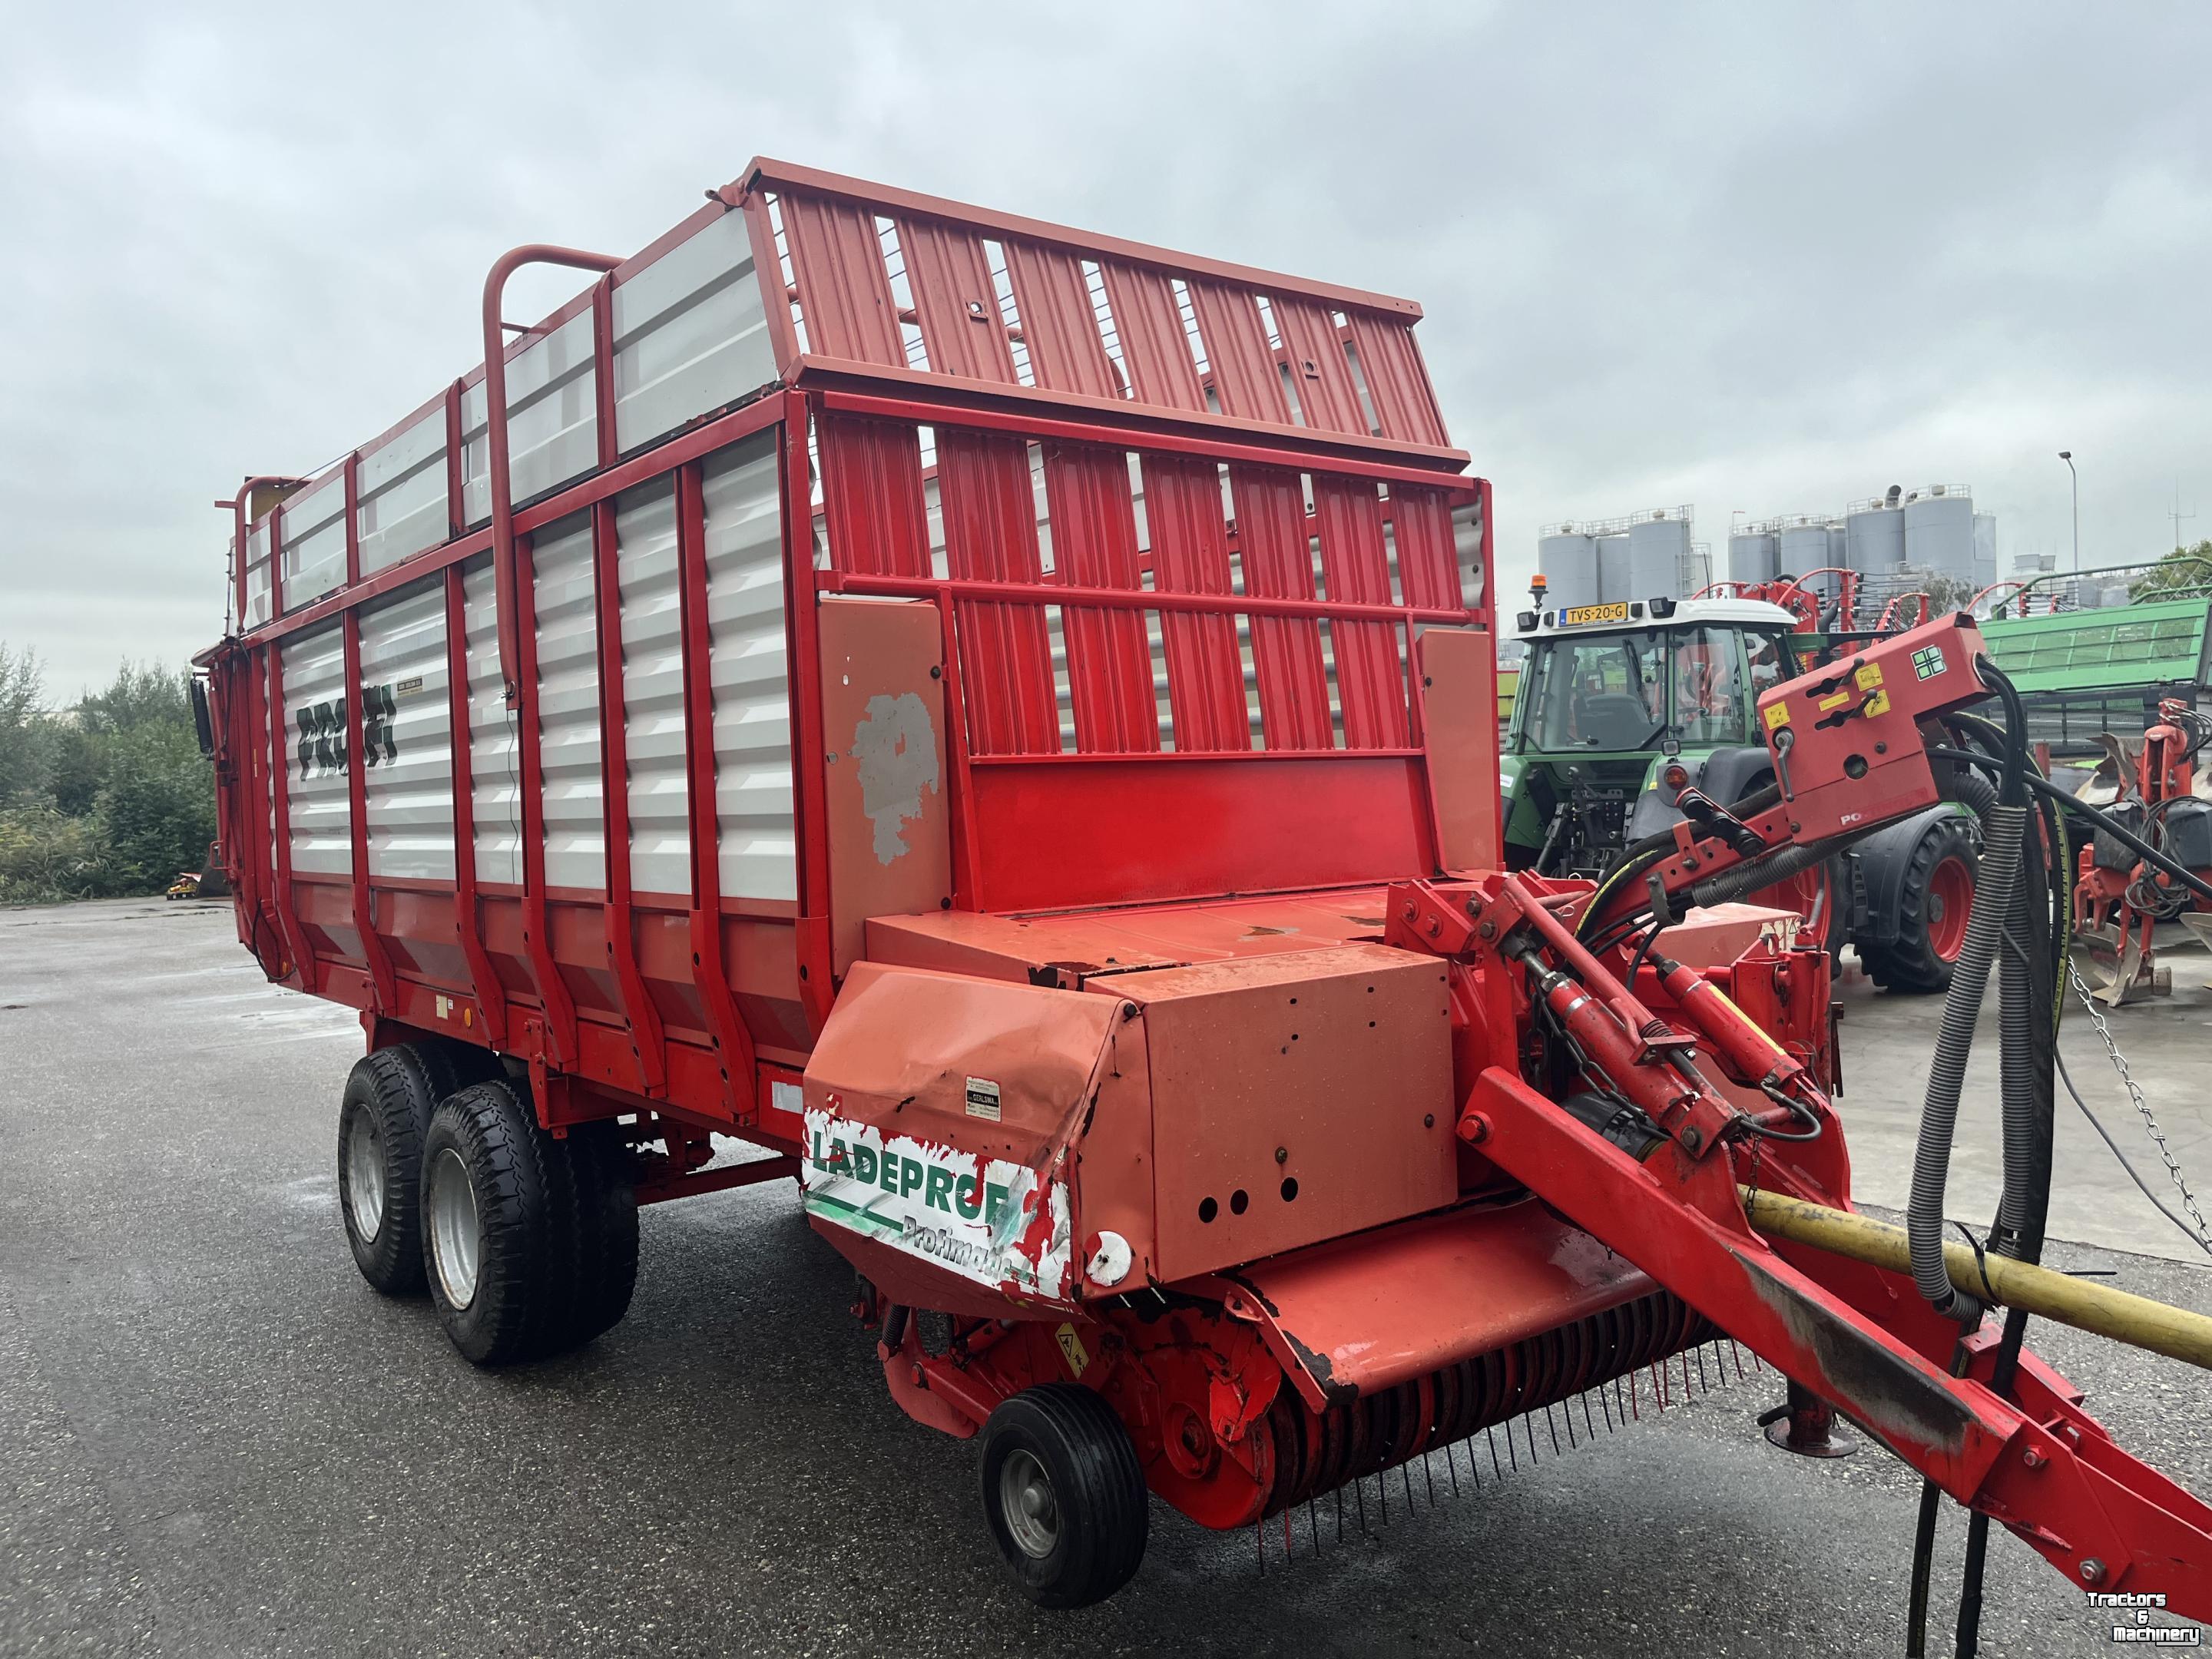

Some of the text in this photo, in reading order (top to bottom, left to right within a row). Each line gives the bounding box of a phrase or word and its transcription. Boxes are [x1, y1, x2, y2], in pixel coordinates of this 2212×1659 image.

[1569, 605, 1622, 622] TVS-20-G
[813, 1131, 1009, 1224] LADEPROF
[903, 1215, 1012, 1280] Profimatic
